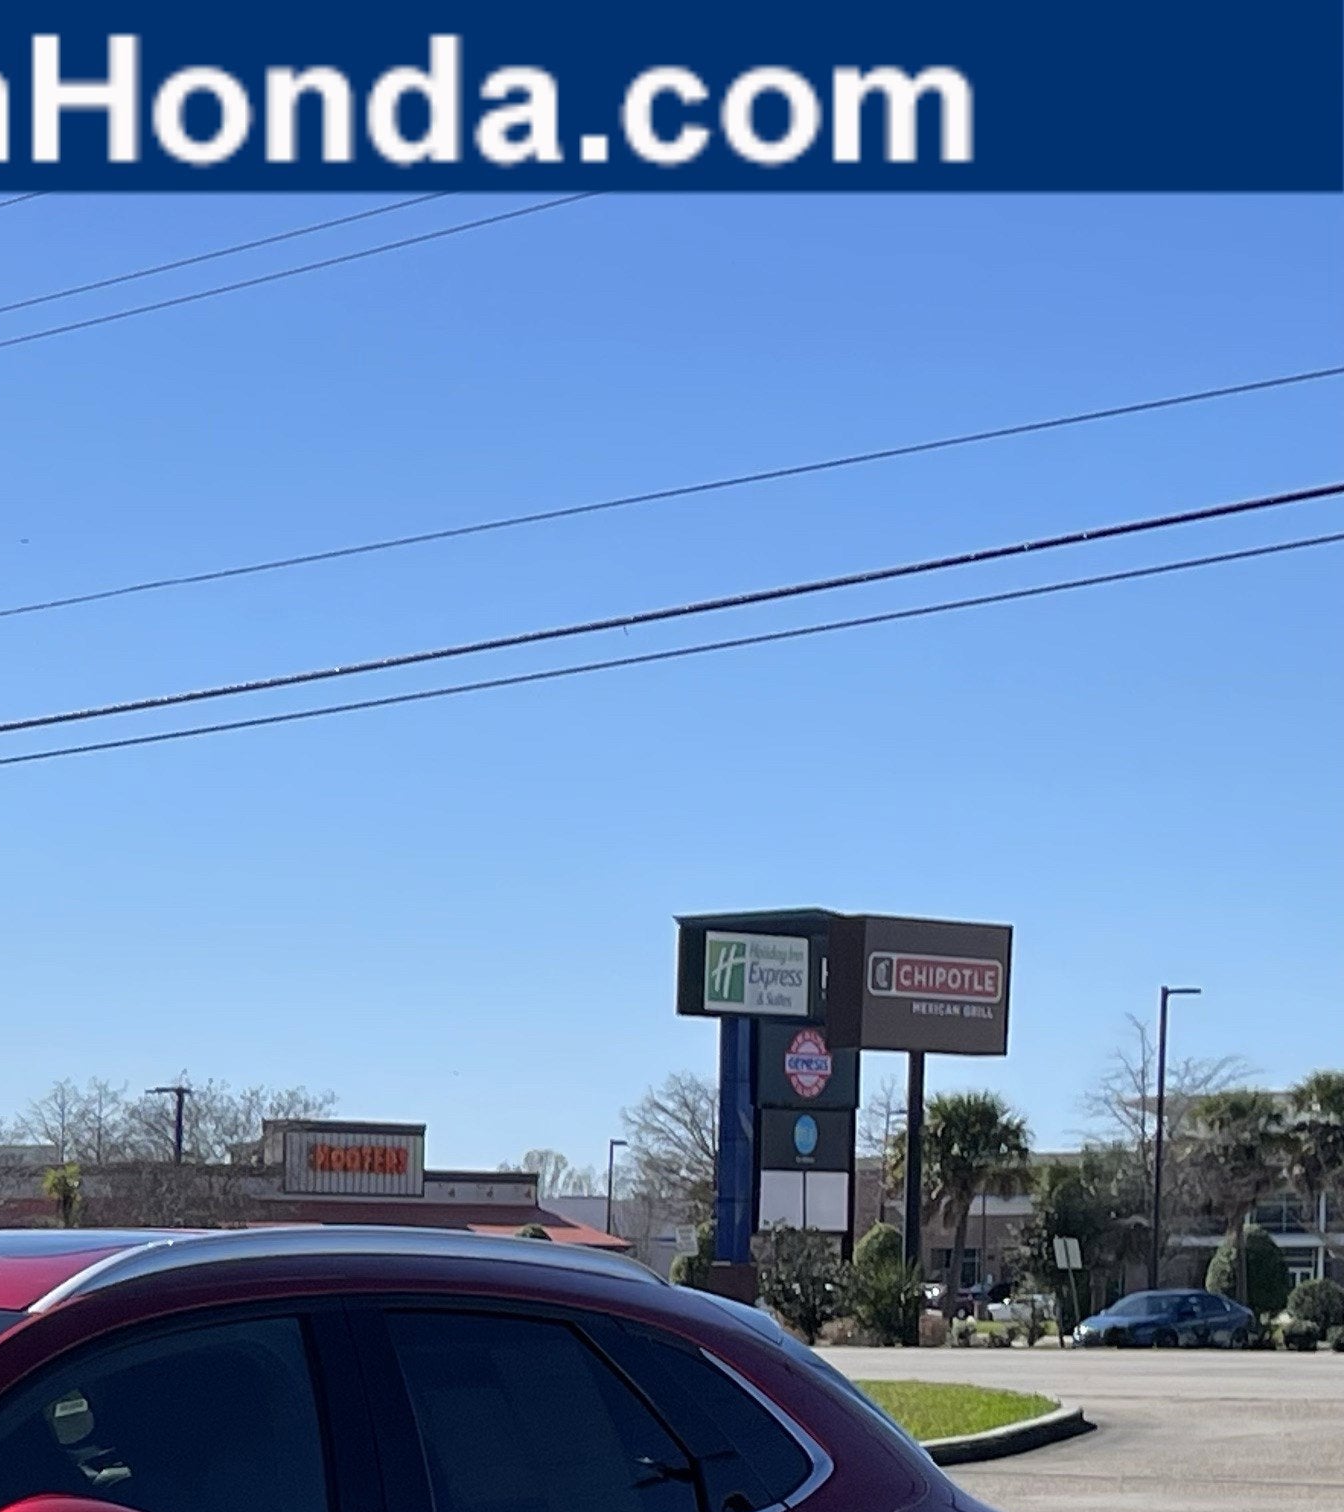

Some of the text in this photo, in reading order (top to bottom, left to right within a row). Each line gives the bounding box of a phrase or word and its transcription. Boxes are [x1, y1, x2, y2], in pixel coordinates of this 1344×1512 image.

[748, 961, 804, 991] Express
[899, 964, 997, 992] CHIPOTLE
[912, 1001, 993, 1019] MEXICAN GRILL
